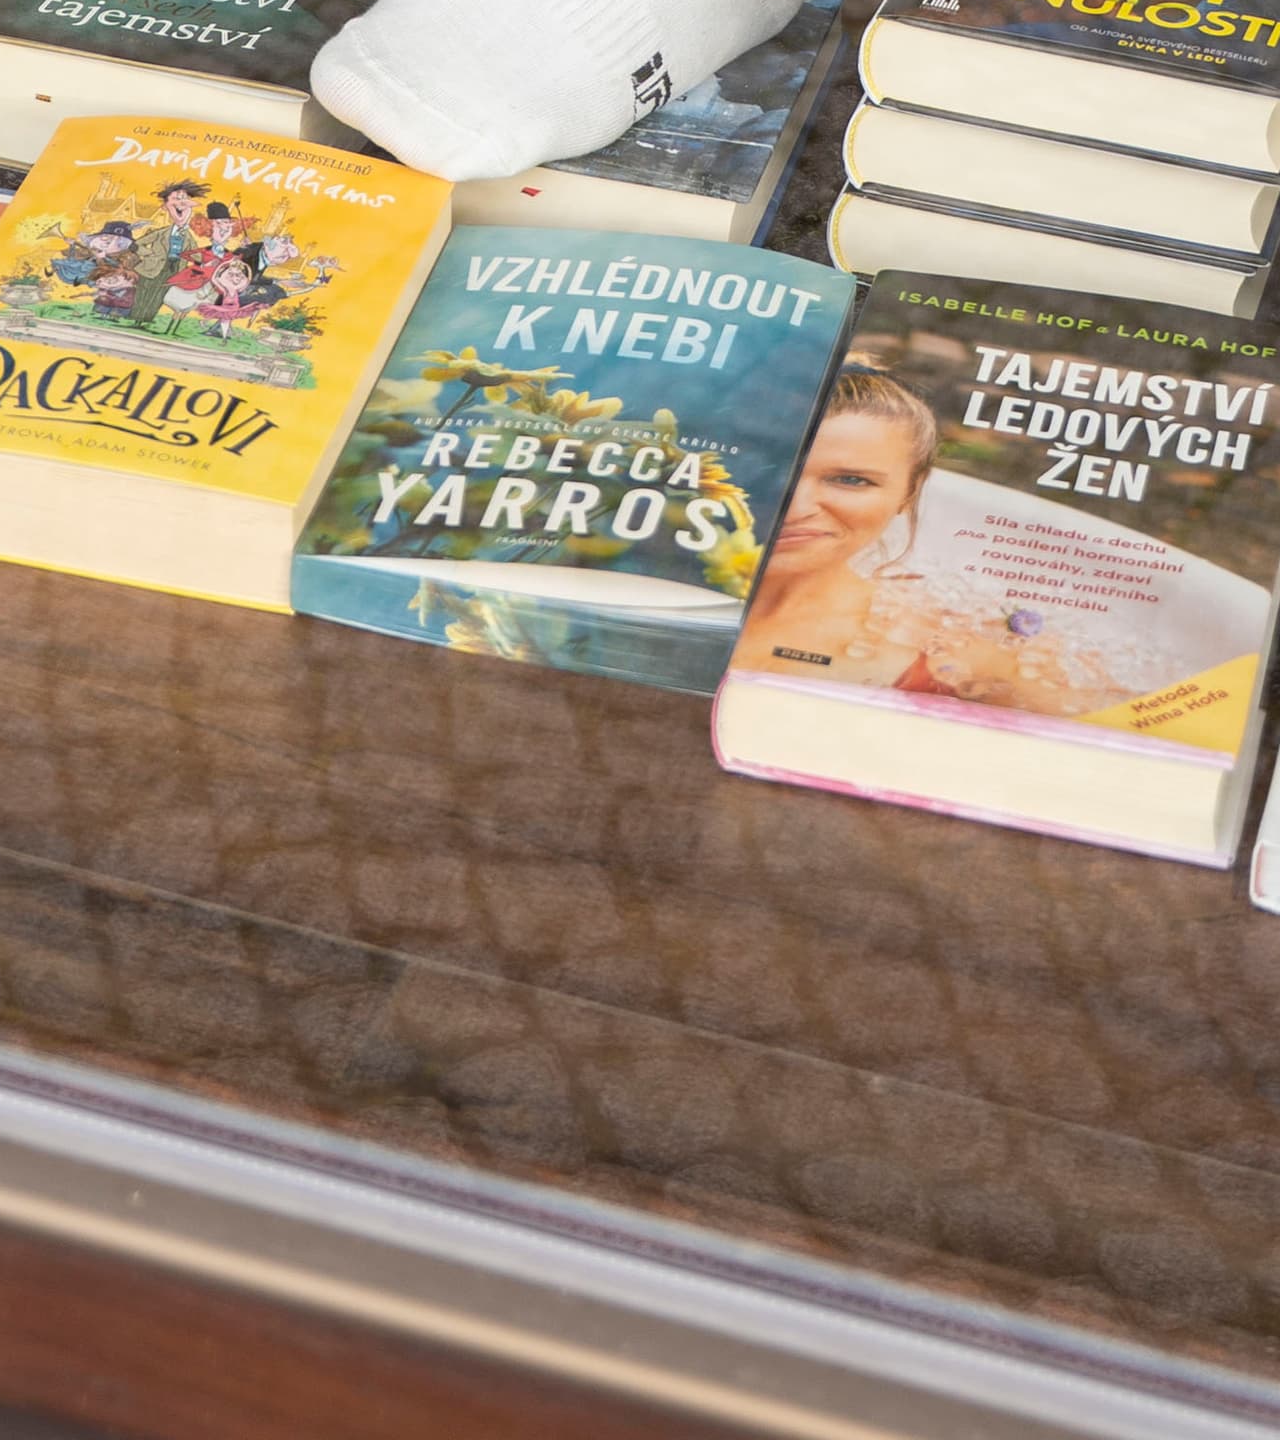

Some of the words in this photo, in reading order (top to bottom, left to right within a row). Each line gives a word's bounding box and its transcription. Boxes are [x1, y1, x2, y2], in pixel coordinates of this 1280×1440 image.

[1185, 51, 1226, 65] LEDU
[74, 136, 218, 178] David
[223, 154, 396, 209] Walliams
[465, 256, 823, 327] VZHLÉDNOUT
[493, 305, 553, 351] K
[561, 307, 739, 370] NEBI
[898, 289, 1026, 323] ISABELLE
[1036, 311, 1092, 332] HOF
[1116, 325, 1209, 352] LAURA
[1220, 341, 1277, 360] HOF
[974, 345, 1275, 426] TAJEMSTVÍ
[72, 434, 127, 454] ADAM
[137, 447, 212, 472] STOWER
[414, 416, 485, 429] AUTORKA
[679, 433, 740, 456] KŘÍDLO
[961, 391, 1252, 470] LEDOVÝCH
[422, 431, 703, 489] REBECCA
[1036, 443, 1150, 502] ŽEN
[371, 473, 728, 554] YARROS
[984, 514, 1018, 531] Síla
[1024, 520, 1088, 542] chladu
[1108, 538, 1167, 555] dechu
[992, 534, 1068, 556] posílení
[1073, 545, 1184, 574] hormonální
[1093, 567, 1152, 585] zdraví
[1005, 587, 1109, 614] potenciálu
[1130, 681, 1200, 714] Metoda
